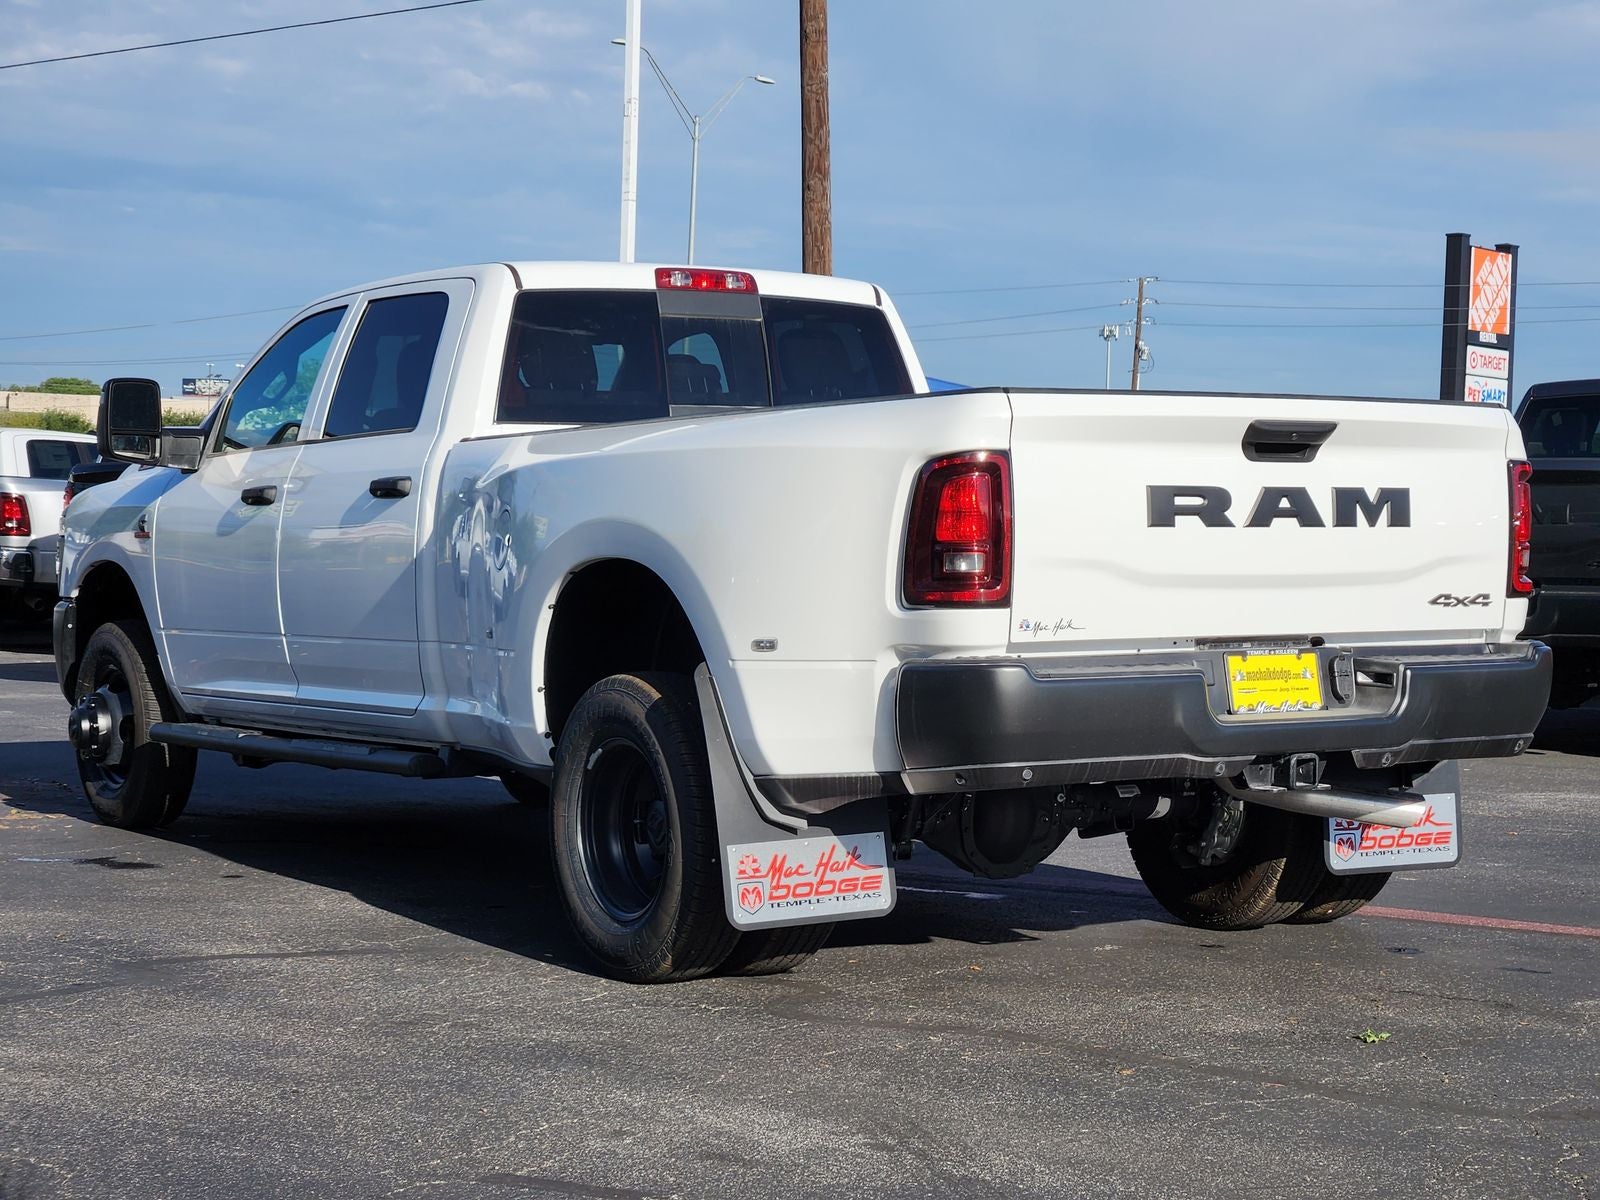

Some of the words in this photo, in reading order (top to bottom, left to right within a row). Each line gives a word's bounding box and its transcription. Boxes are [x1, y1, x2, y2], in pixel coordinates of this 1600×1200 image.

[1470, 254, 1509, 332] HOME
[1479, 354, 1507, 371] TARGET
[1146, 485, 1411, 528] RAM
[1427, 593, 1493, 607] 4x4
[1031, 620, 1051, 638] Mac
[1052, 617, 1087, 637] Haik
[1246, 667, 1302, 683] machaikdodge.com
[1255, 701, 1278, 714] Mac
[1359, 831, 1453, 850] DODGE
[1360, 848, 1405, 857] TEMPLE
[1411, 845, 1451, 854] TEXAS
[765, 853, 813, 892] Mac
[814, 843, 884, 889] Haik
[767, 874, 884, 901] DODGE
[768, 896, 826, 909] TEMPLE
[835, 891, 883, 902] TEXAS
